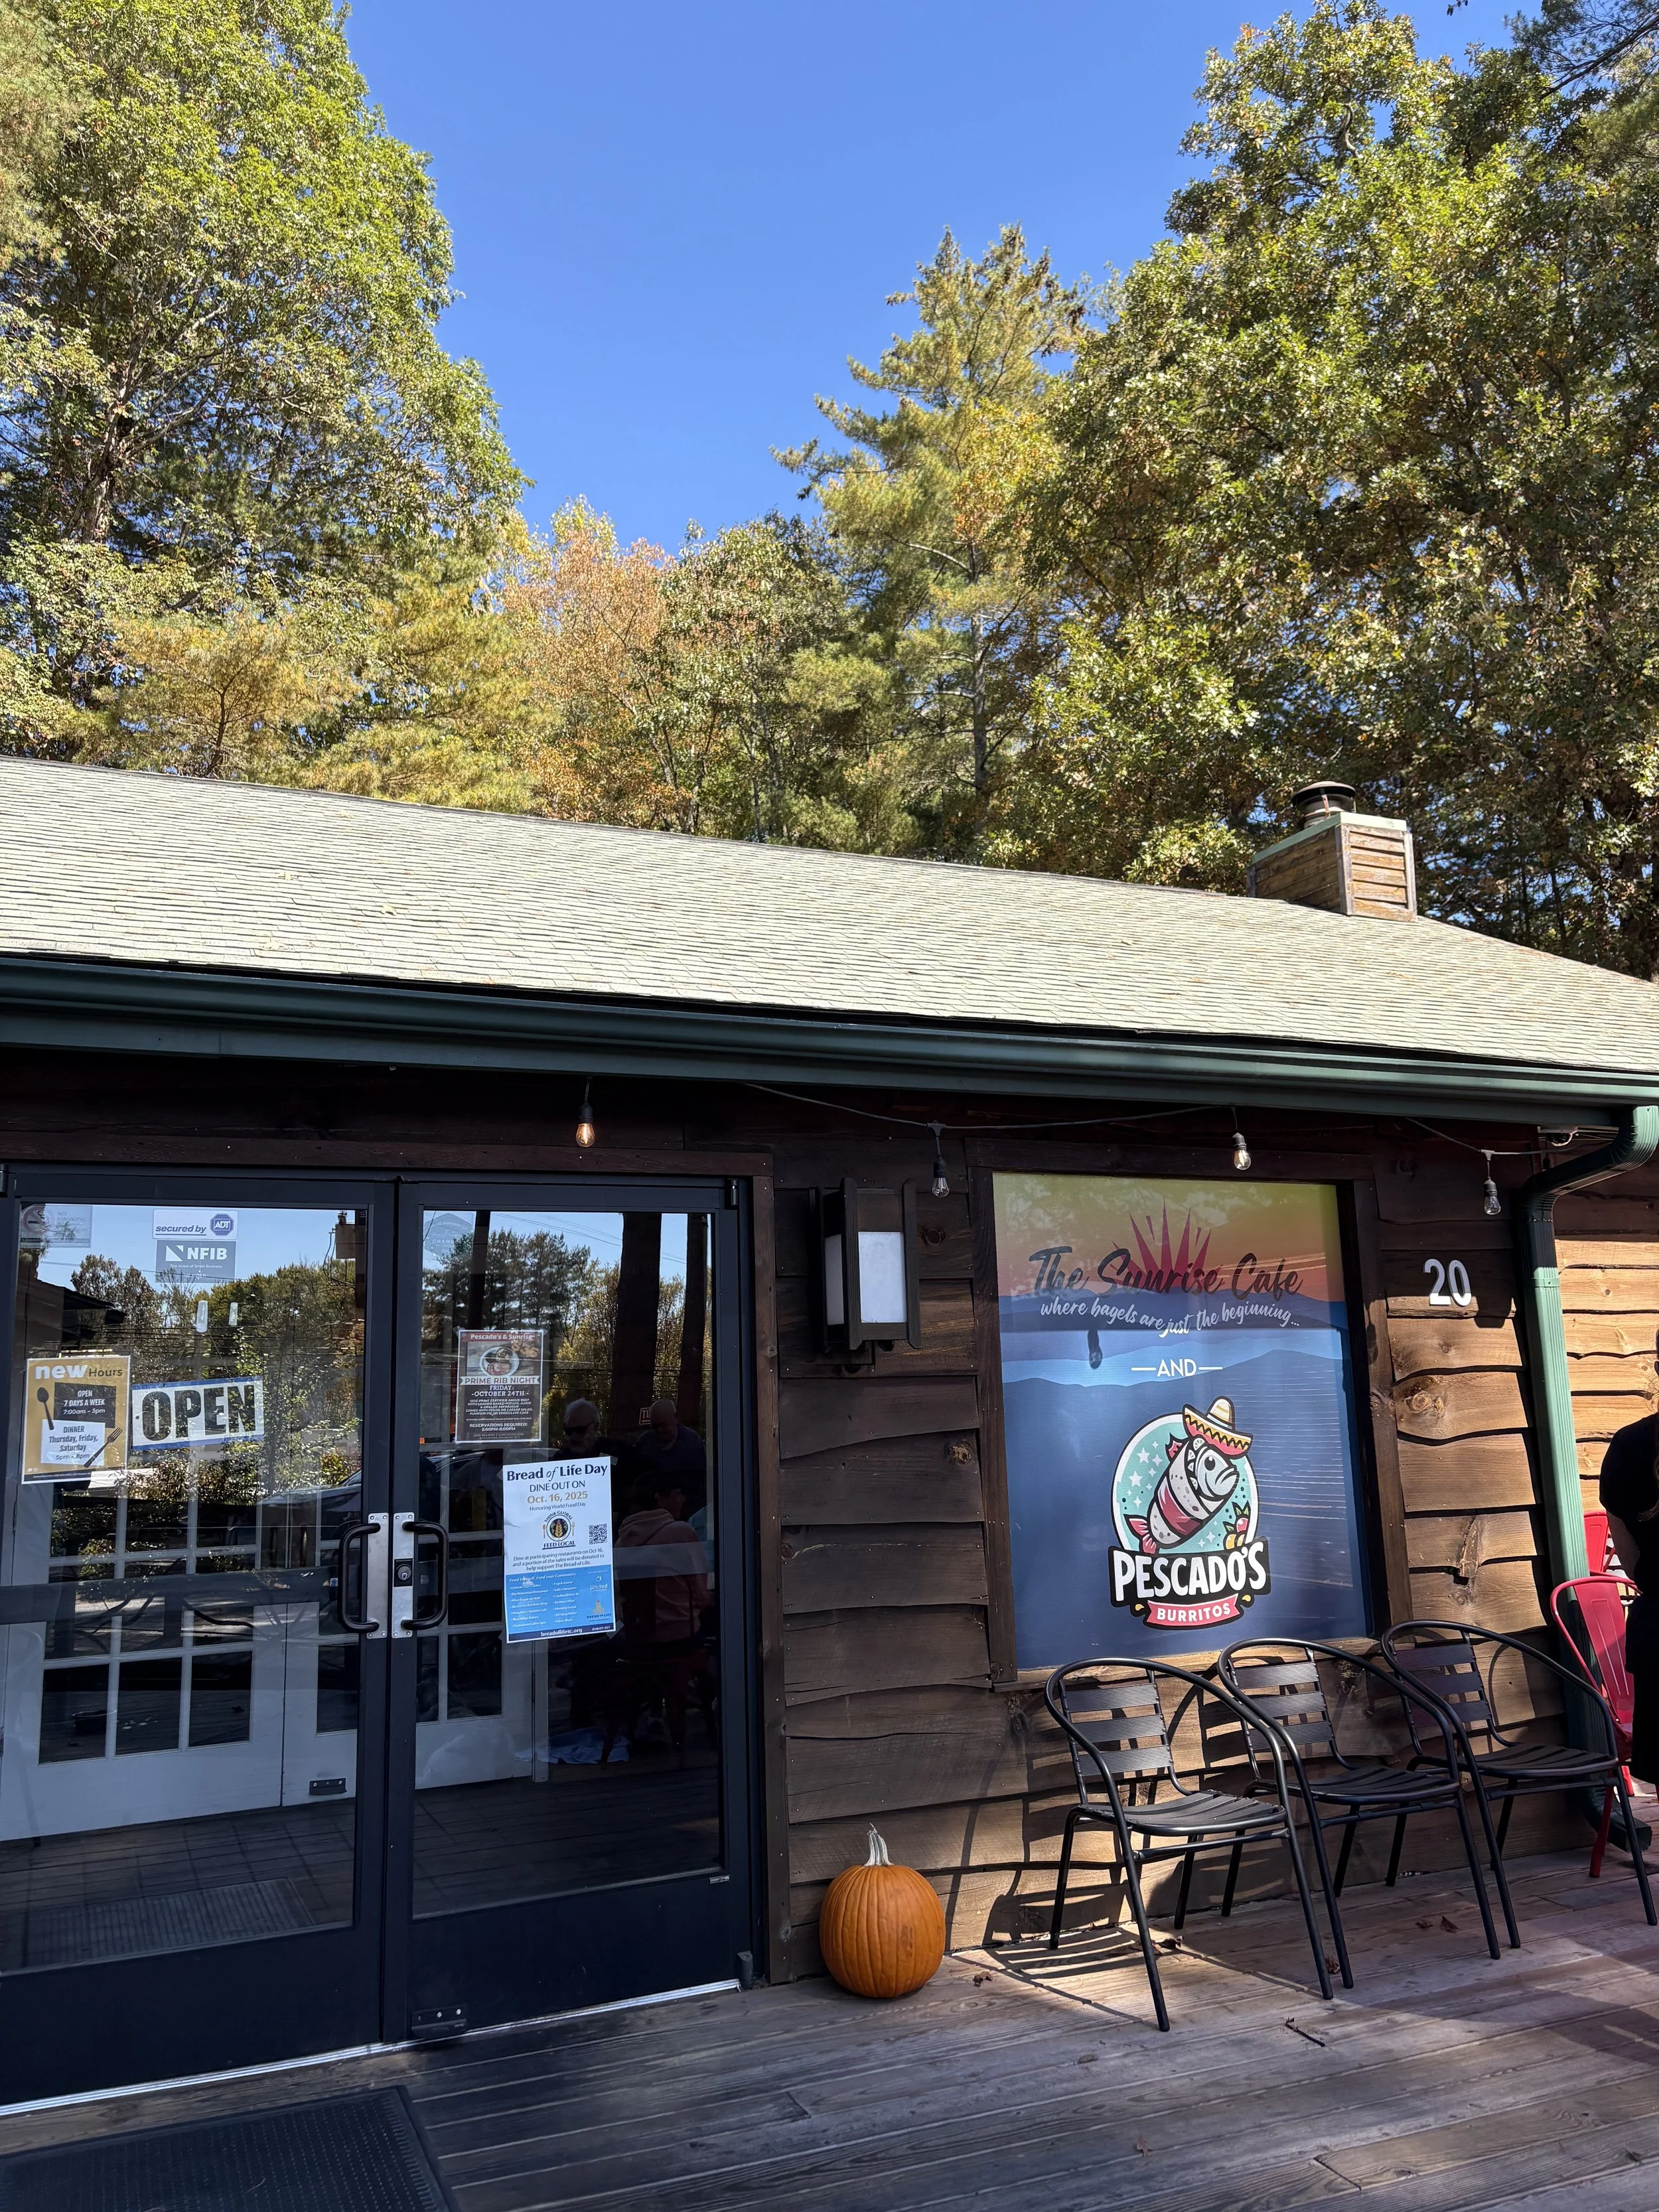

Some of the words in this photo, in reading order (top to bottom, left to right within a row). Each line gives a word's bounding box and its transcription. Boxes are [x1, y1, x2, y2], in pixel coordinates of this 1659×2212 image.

[195, 1225, 206, 1234] by
[186, 1247, 227, 1260] NFIB
[1029, 1246, 1090, 1296] The
[1097, 1248, 1224, 1296] Sunrise
[1232, 1252, 1304, 1301] Cafe
[1424, 1259, 1472, 1306] 20
[1041, 1301, 1086, 1316] where
[1090, 1297, 1137, 1326] bagels
[1139, 1313, 1165, 1330] are
[1159, 1314, 1190, 1338] just
[1196, 1308, 1220, 1329] the
[1222, 1301, 1300, 1328] beginning...
[35, 1364, 88, 1379] new
[89, 1368, 123, 1377] Hours
[1157, 1359, 1197, 1377] AND
[142, 1385, 256, 1441] OPEN
[507, 1467, 543, 1481] Bread
[546, 1467, 559, 1481] of
[560, 1465, 582, 1477] Life
[585, 1464, 608, 1476] Day
[530, 1483, 550, 1492] DINE
[549, 1493, 562, 1502] 16,
[565, 1491, 588, 1501] 2025
[544, 1511, 557, 1522] THINK
[557, 1511, 573, 1520] GLOBAL
[1113, 1542, 1267, 1601] PESCADO'S
[1156, 1602, 1231, 1622] BURRITOS
